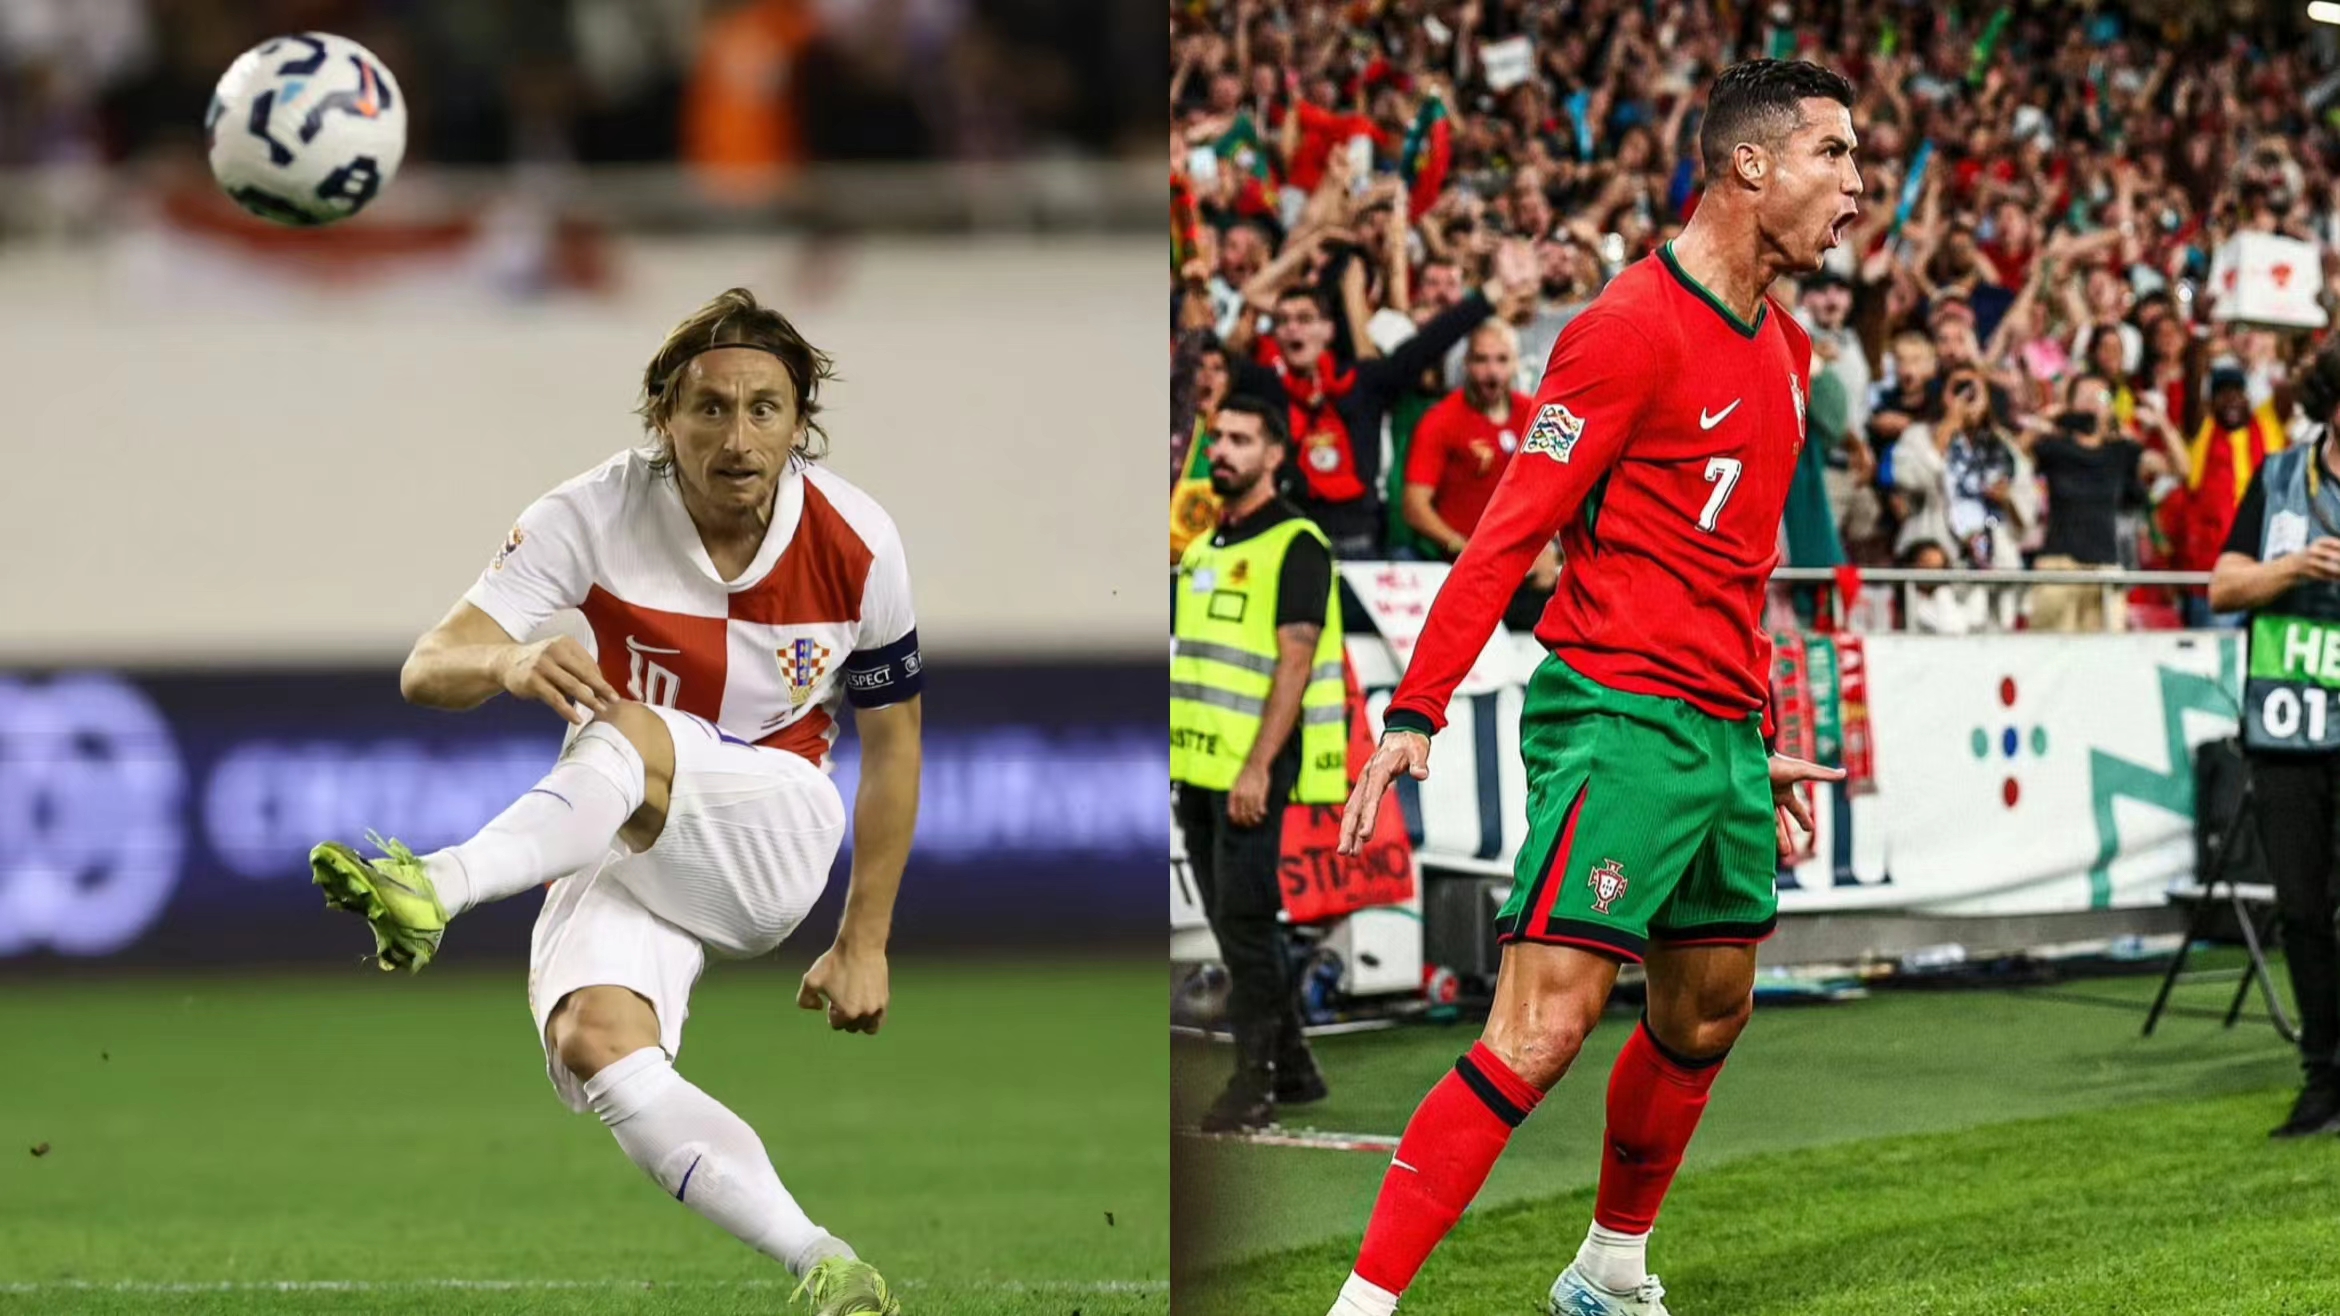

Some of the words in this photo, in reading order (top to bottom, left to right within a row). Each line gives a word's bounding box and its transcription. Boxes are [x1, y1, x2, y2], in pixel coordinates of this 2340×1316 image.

[1695, 457, 1742, 532] 7
[626, 646, 681, 708] 10
[2263, 687, 2340, 742] 01
